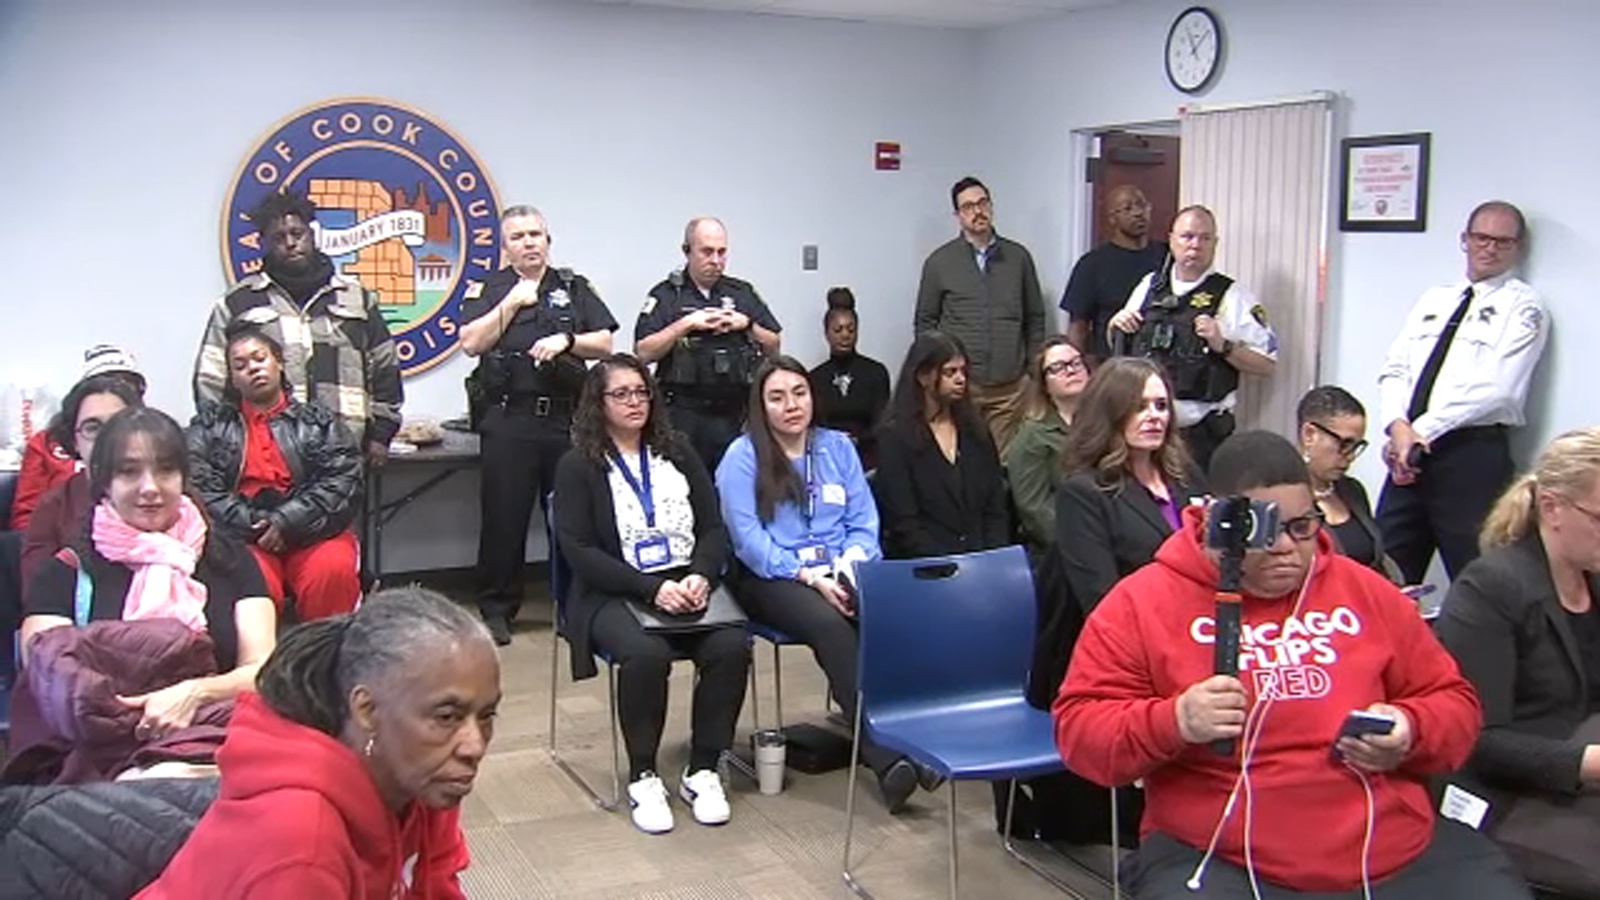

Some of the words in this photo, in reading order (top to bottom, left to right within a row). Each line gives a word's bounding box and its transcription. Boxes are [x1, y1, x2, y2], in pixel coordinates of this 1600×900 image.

[255, 141, 293, 184] OF
[312, 113, 423, 145] COOK
[324, 221, 385, 249] JANUARY
[390, 217, 420, 231] 1831
[1190, 606, 1361, 646] CICAGO
[1238, 637, 1338, 671] FLIPS
[1253, 664, 1332, 699] RED
